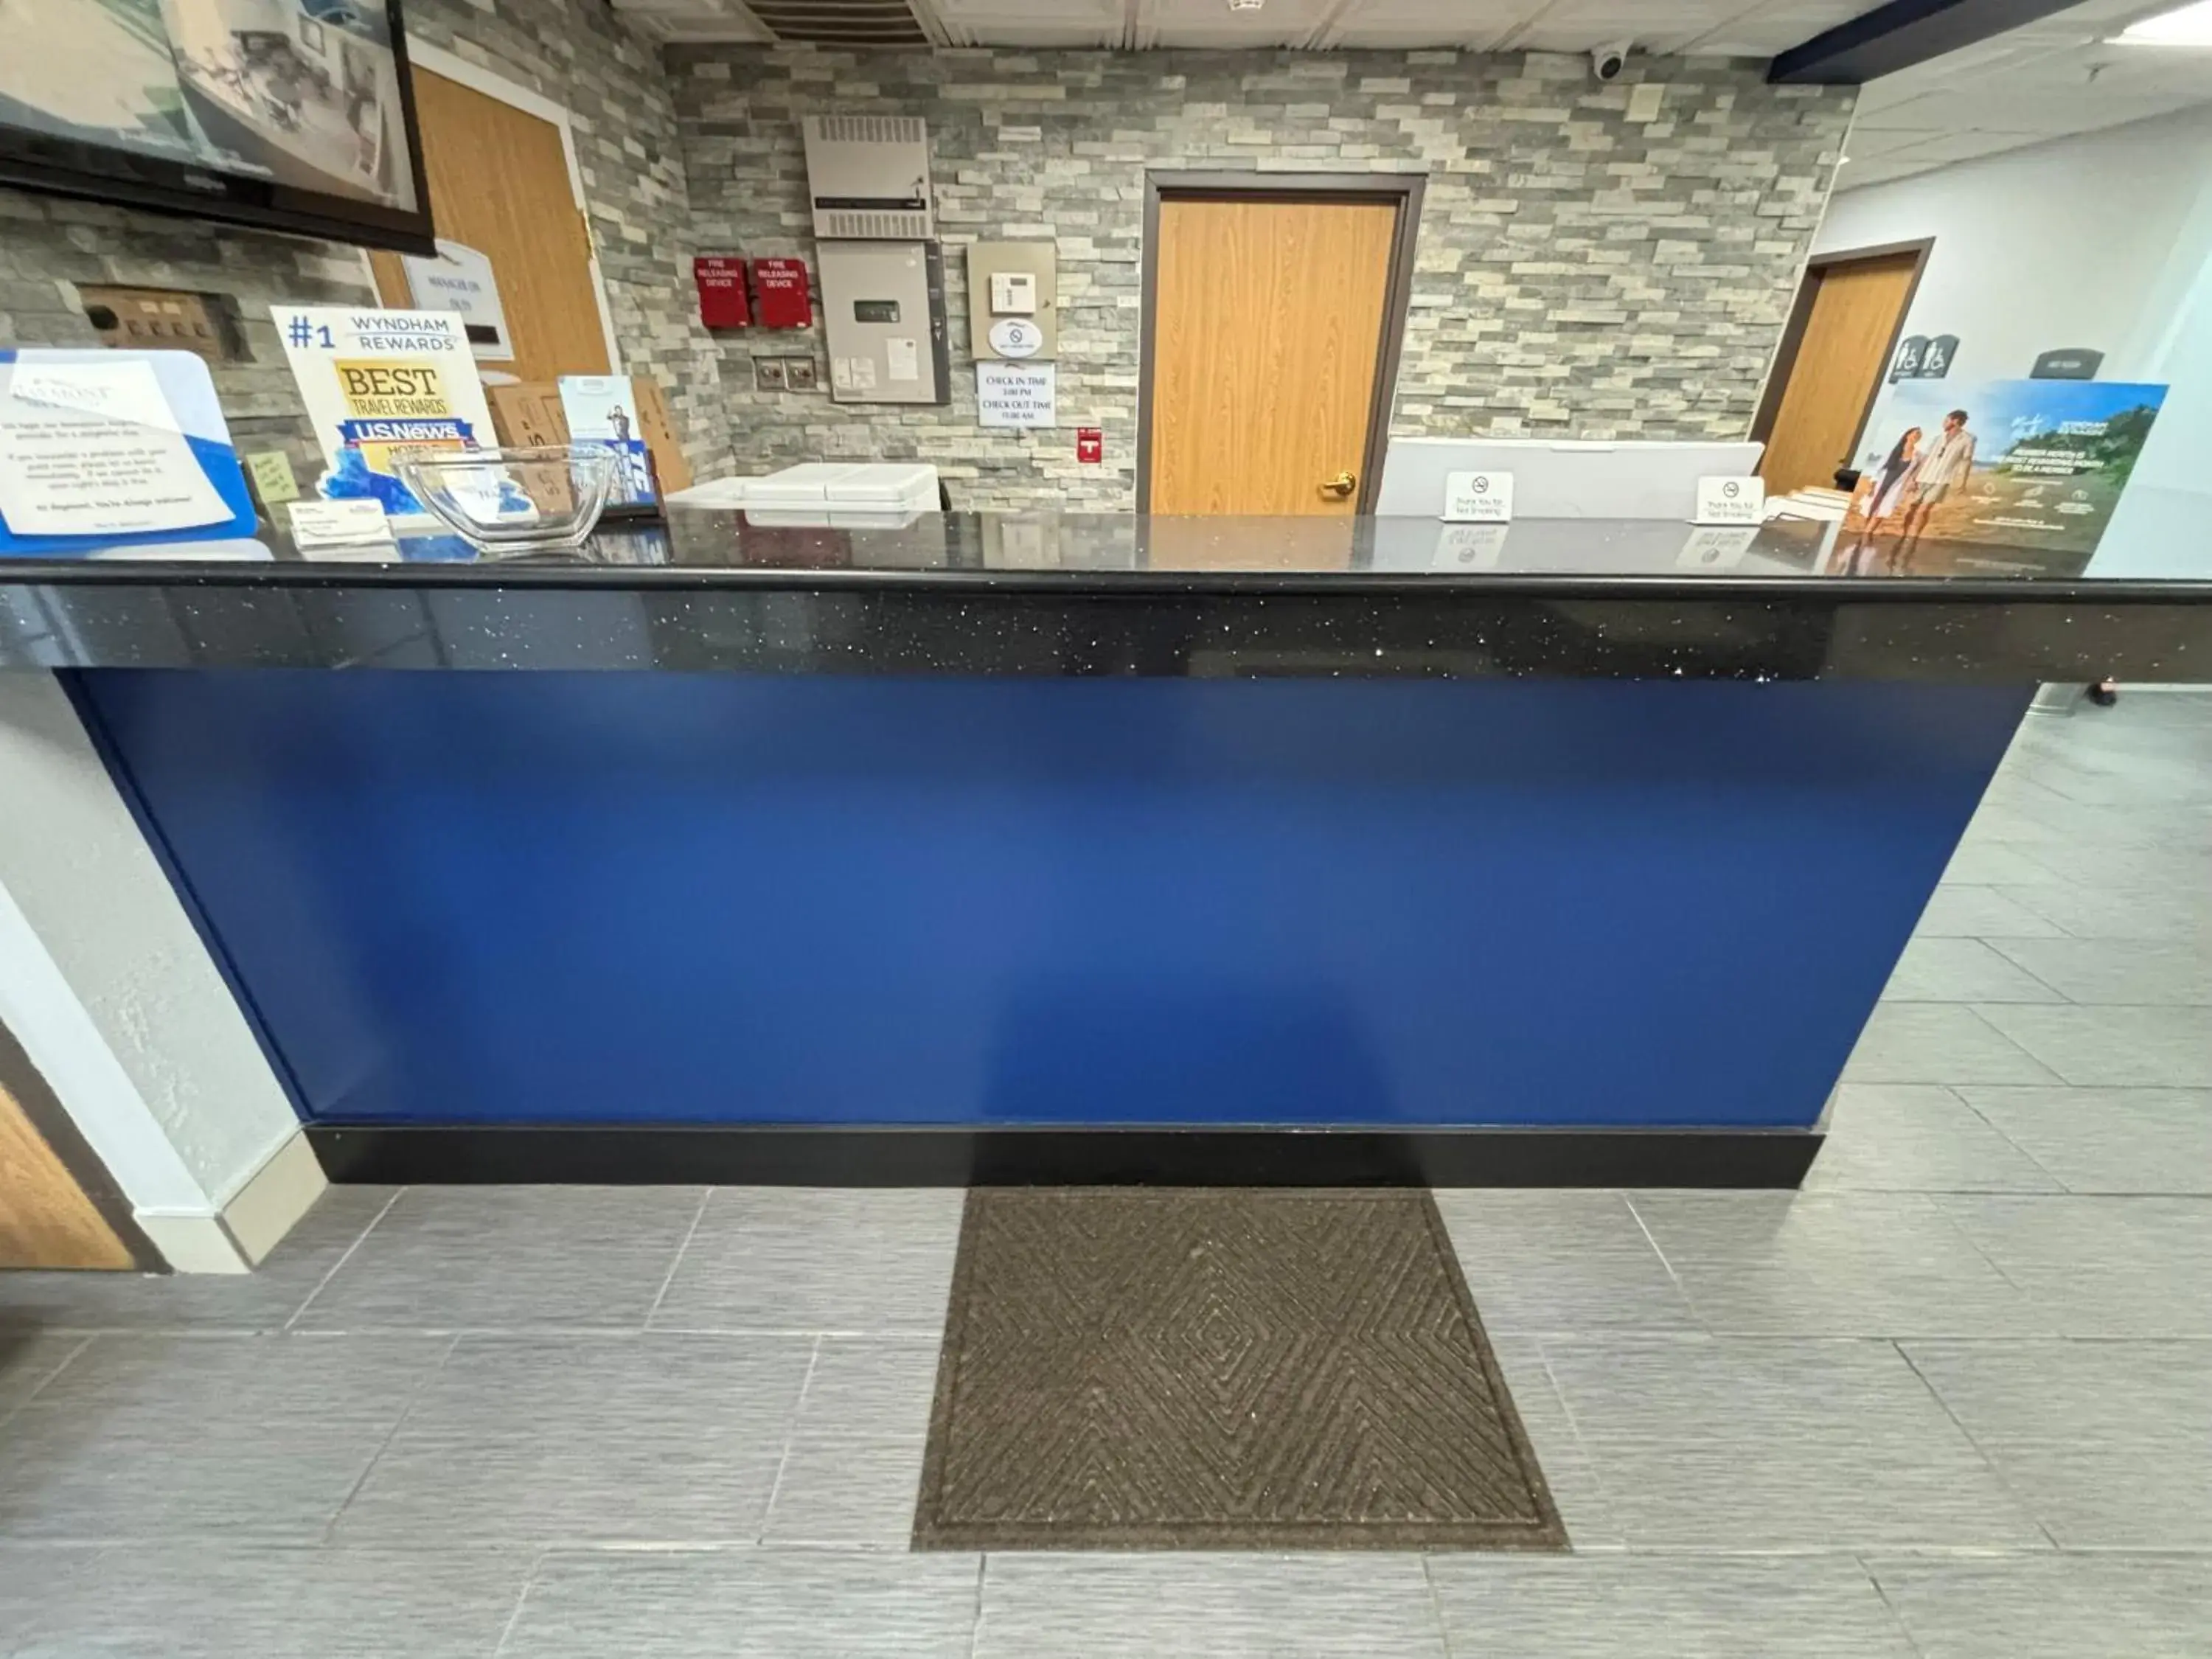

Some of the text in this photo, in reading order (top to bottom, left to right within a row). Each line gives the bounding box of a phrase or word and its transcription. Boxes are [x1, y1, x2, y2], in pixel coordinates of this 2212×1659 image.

[288, 315, 335, 349] #1
[351, 316, 450, 332] WYNDHAM
[359, 336, 456, 351] REWARDS
[341, 367, 437, 396] BEST
[352, 398, 448, 415] TRAVEL REWARDS
